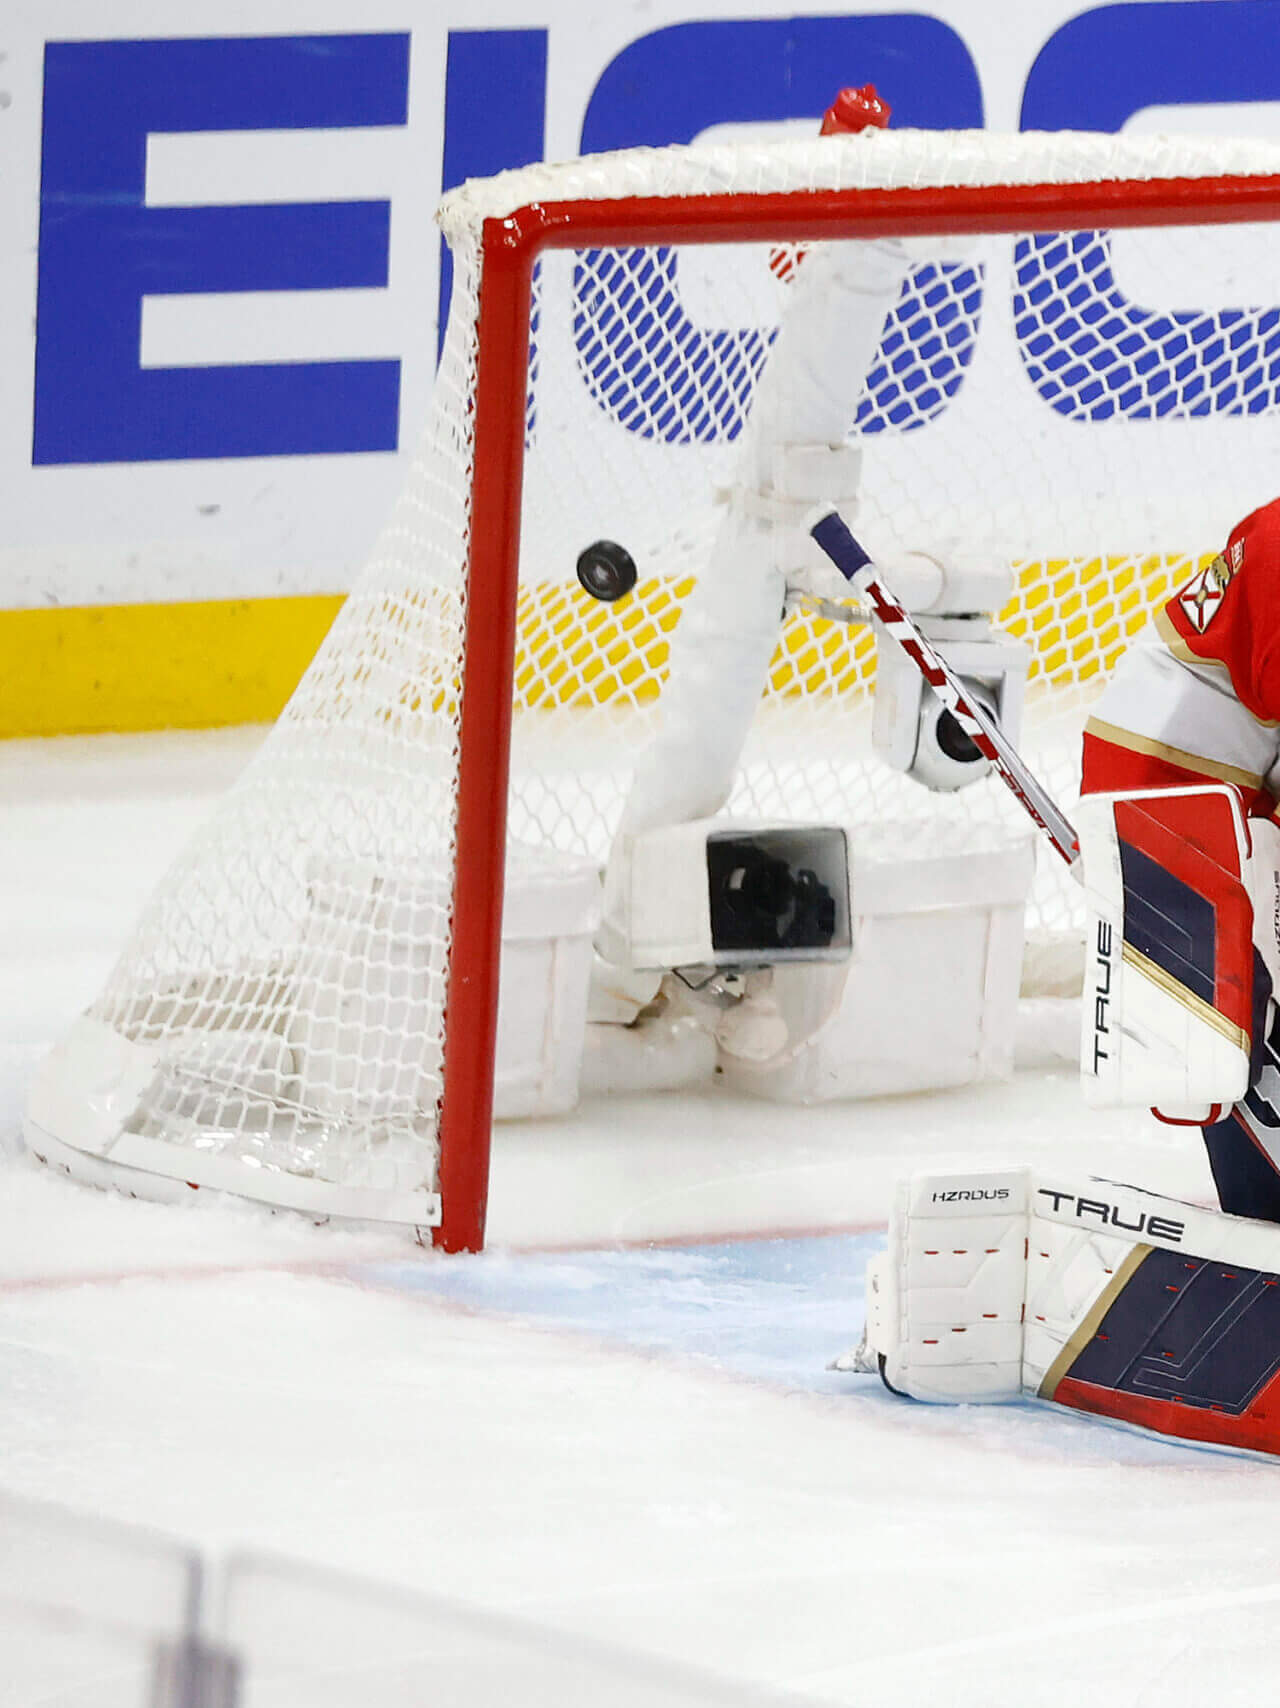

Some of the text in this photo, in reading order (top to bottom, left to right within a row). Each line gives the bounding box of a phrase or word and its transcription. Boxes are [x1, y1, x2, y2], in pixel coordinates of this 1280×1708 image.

[1094, 919, 1112, 1076] TRUE
[932, 1188, 1010, 1202] HZRDUS
[1037, 1188, 1186, 1243] TRUE
